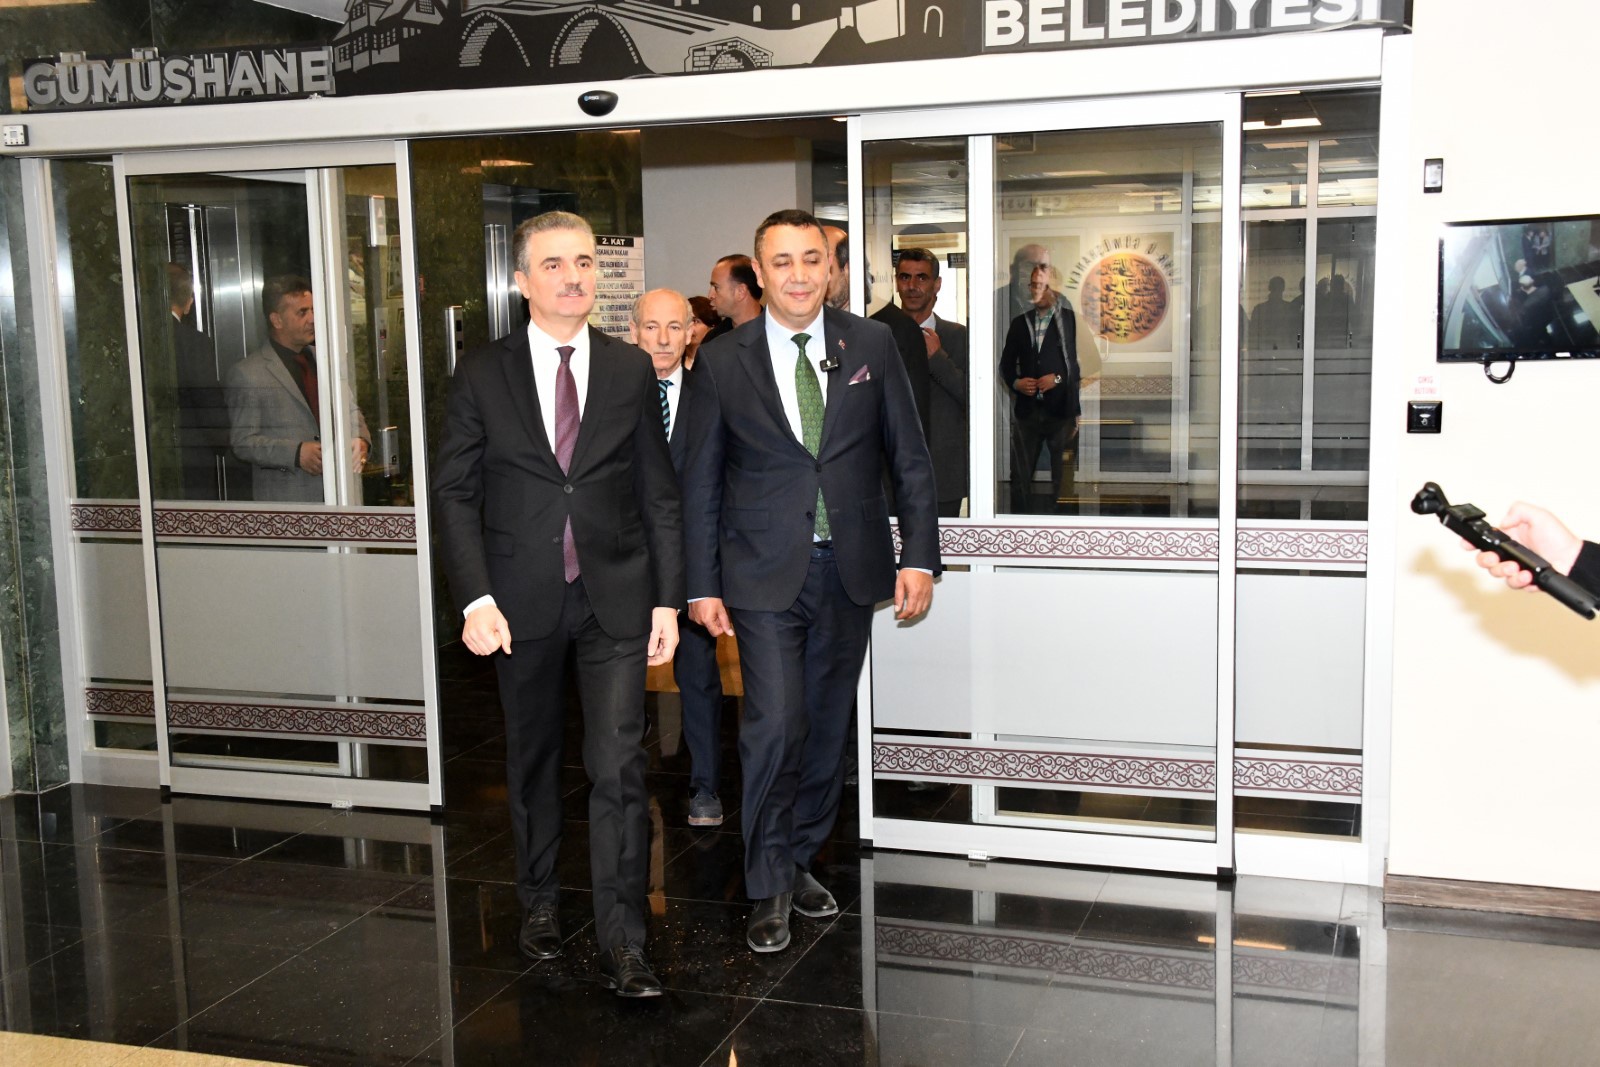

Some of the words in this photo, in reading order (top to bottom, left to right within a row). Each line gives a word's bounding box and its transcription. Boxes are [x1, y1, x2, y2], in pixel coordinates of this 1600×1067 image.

[23, 46, 335, 106] GÜMÜŞHANE
[602, 237, 609, 245] 2.
[610, 238, 625, 246] KAT
